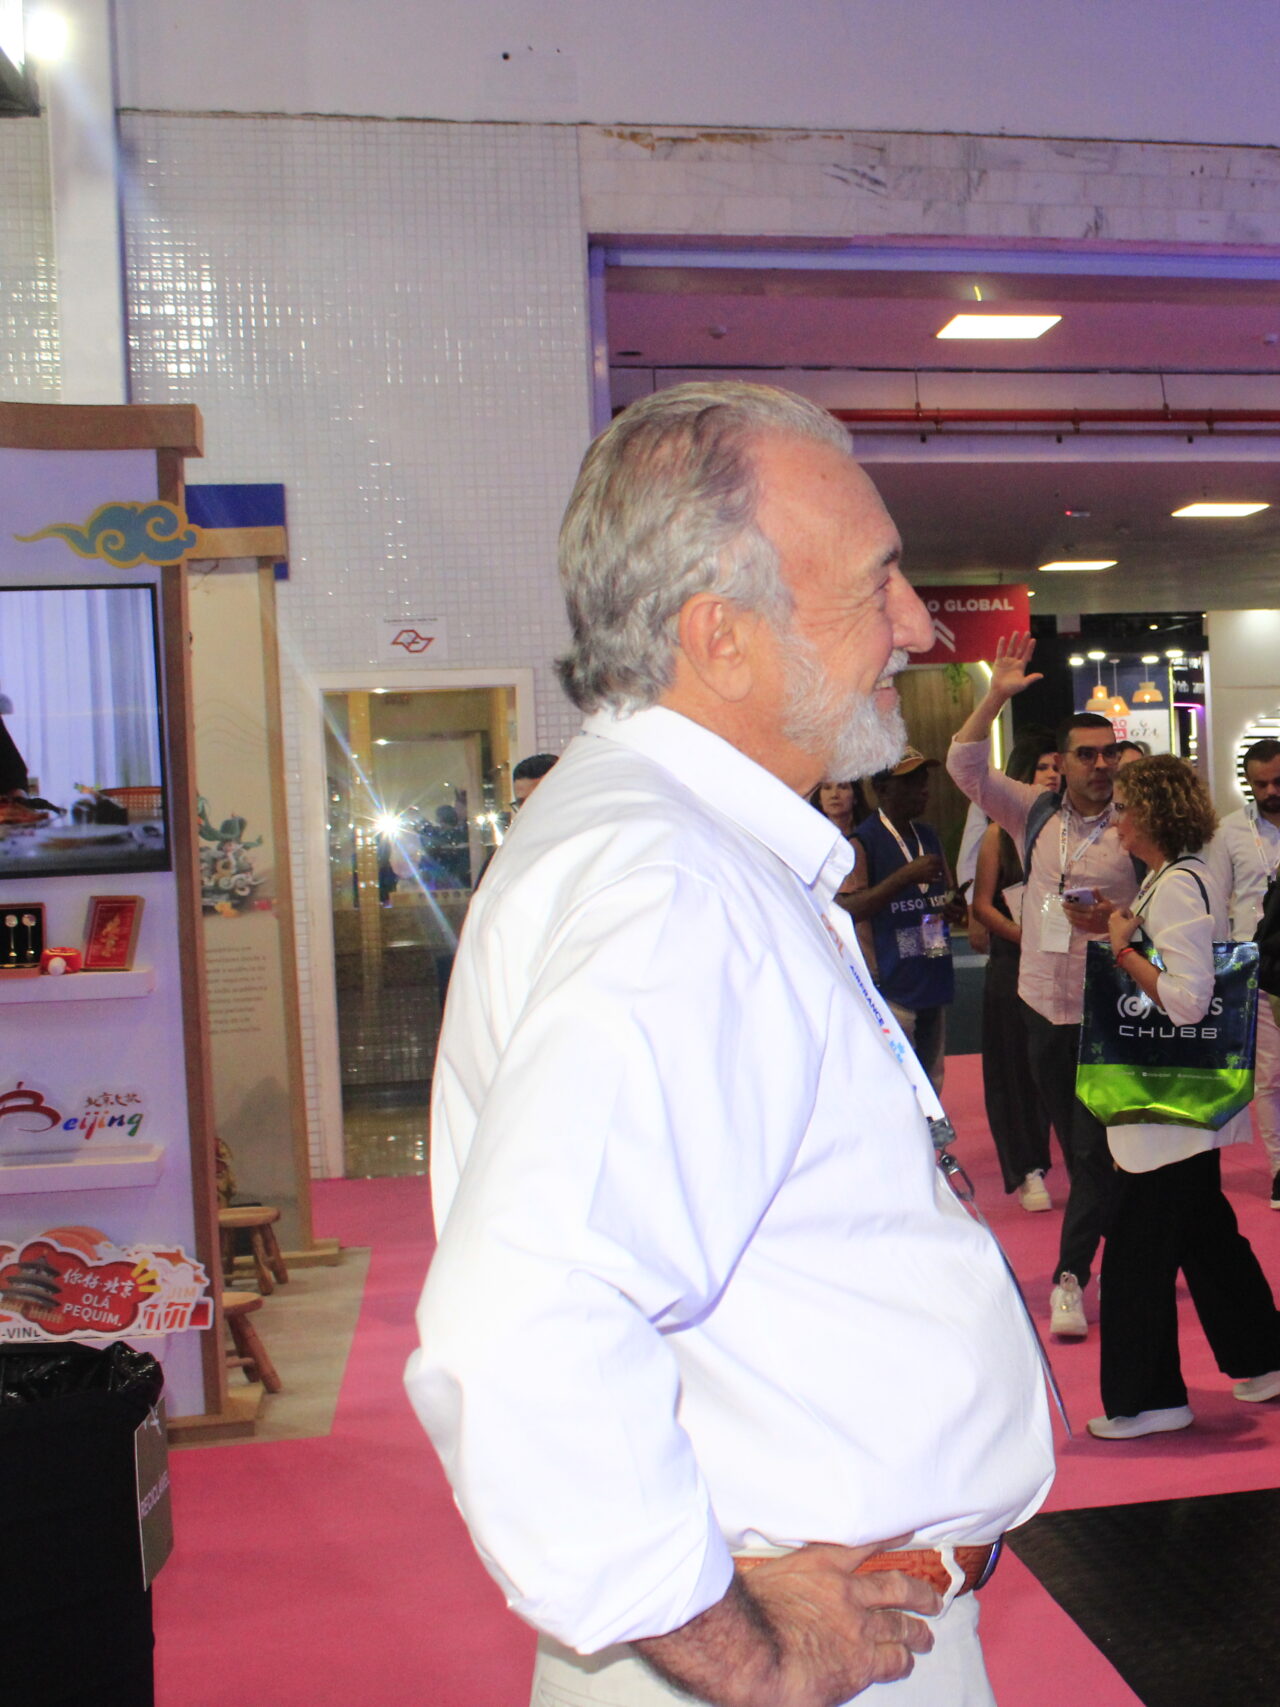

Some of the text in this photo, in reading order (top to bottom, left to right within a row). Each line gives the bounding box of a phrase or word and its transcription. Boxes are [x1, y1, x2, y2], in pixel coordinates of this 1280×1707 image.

[944, 598, 1014, 611] GLOBAL
[1118, 1025, 1218, 1039] CHUBB
[82, 1293, 111, 1309] OLÁ
[63, 1303, 122, 1327] PEQUIM.
